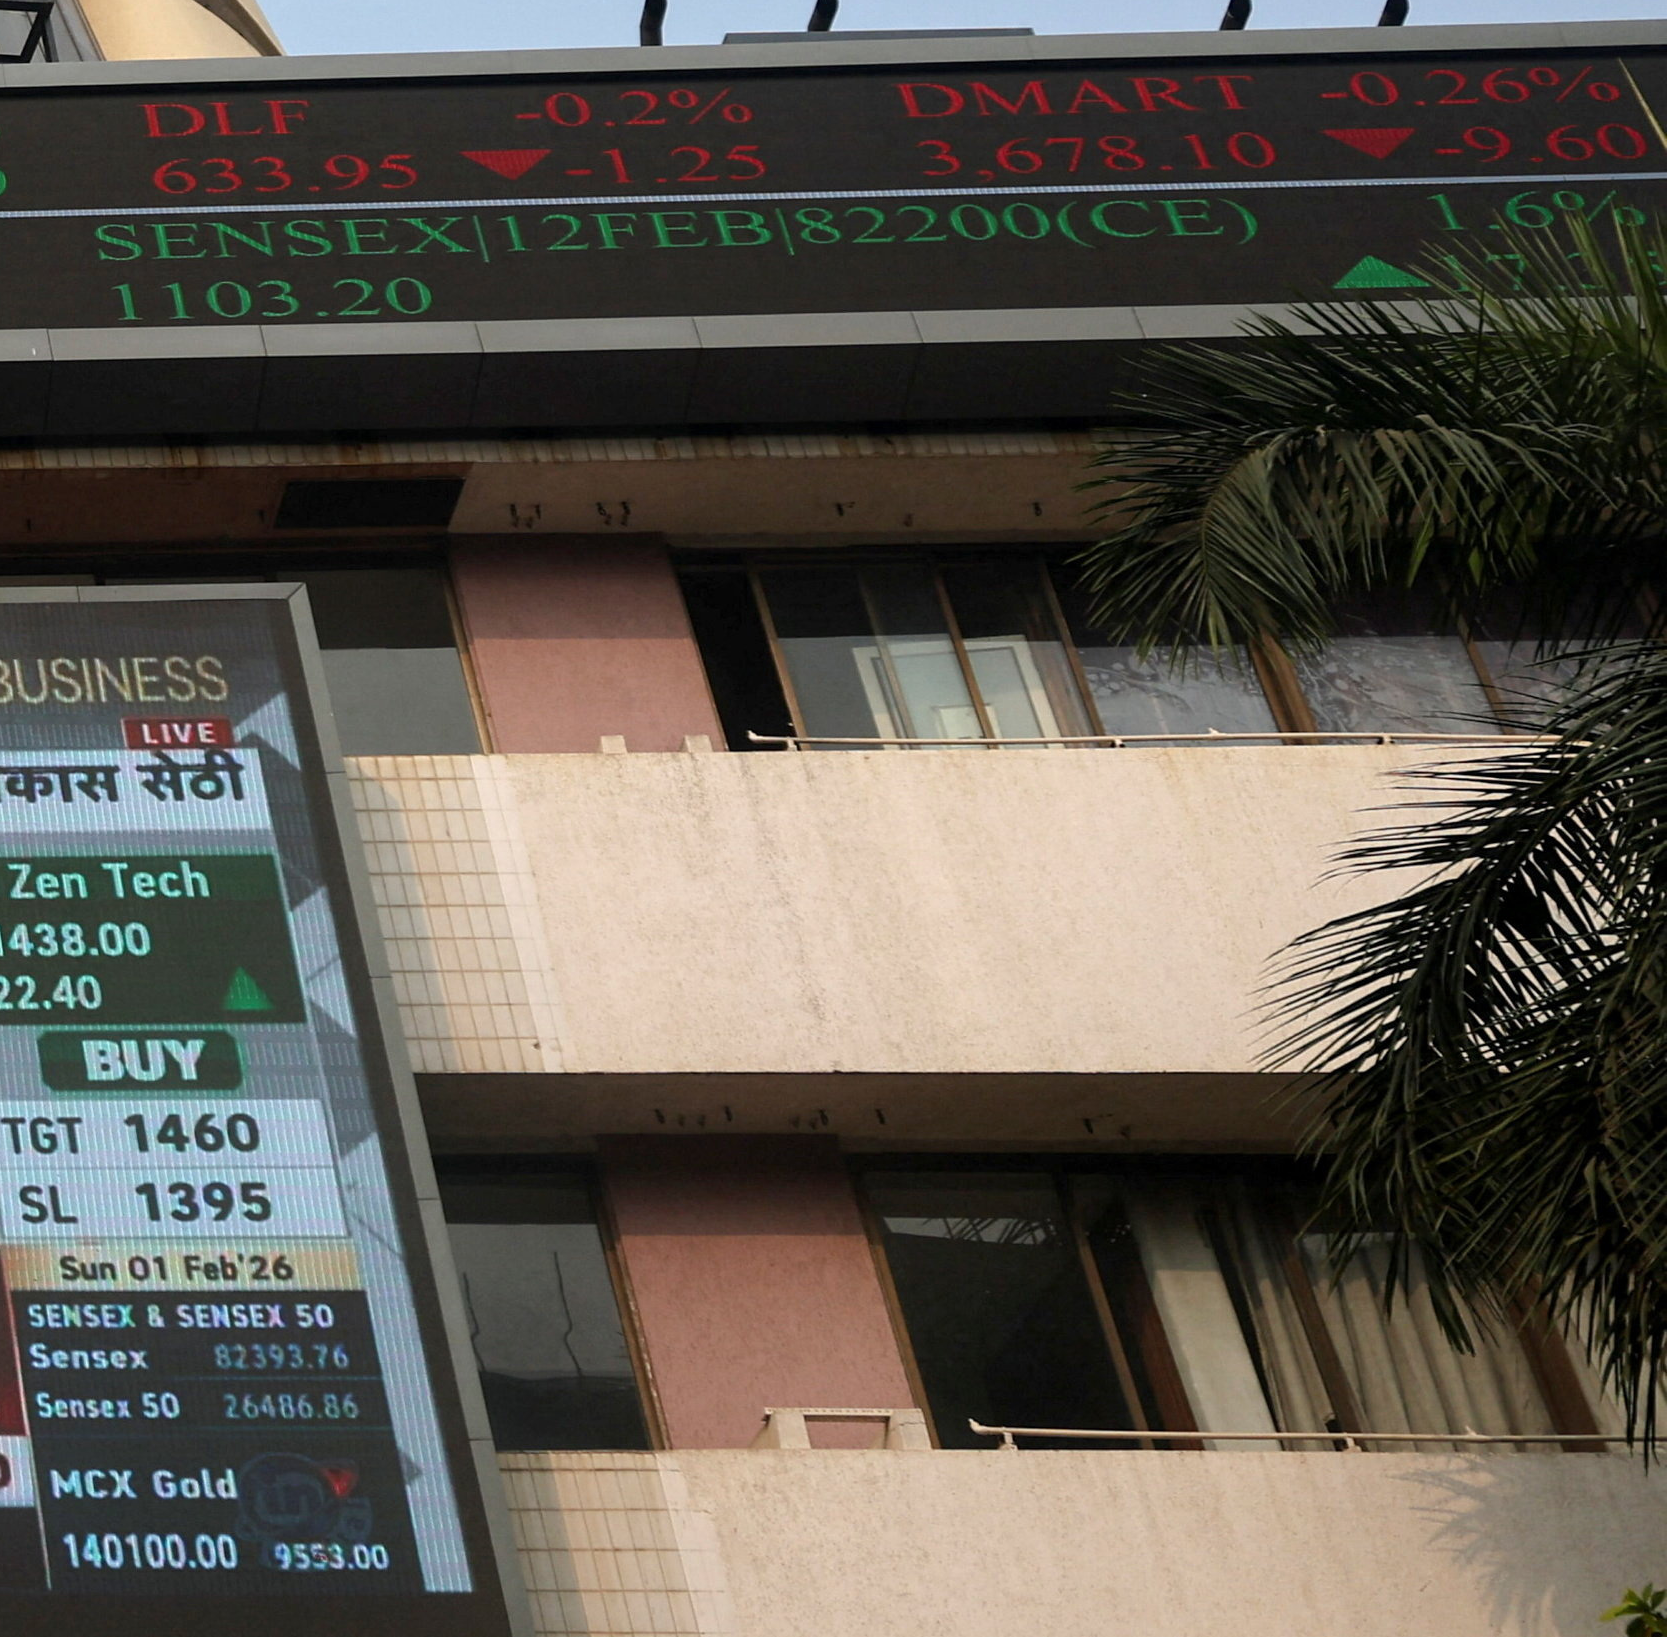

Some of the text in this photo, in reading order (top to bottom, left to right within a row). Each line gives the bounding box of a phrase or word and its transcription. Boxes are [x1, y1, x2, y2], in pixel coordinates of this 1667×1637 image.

[141, 99, 310, 138] DLF
[514, 89, 753, 127] -0.2%
[896, 75, 1252, 118] DMART
[1320, 67, 1621, 106] -0.26%
[152, 153, 418, 195] 633.95
[565, 144, 767, 184] -1.25
[918, 131, 1277, 179] 3,678.10
[1434, 123, 1648, 163] -9.60
[1427, 190, 1647, 231] 1.6%
[113, 277, 434, 321] 1103.20
[141, 722, 216, 745] LIVE
[136, 750, 245, 802] सेठी
[9, 860, 210, 899] Zen Tech
[81, 1039, 205, 1082] BUY
[0, 1112, 260, 1155] TGT 1460
[18, 1181, 272, 1225] SL 1395
[59, 1255, 117, 1282] Sun
[128, 1255, 168, 1282] 01
[28, 1303, 335, 1329] SENSEX & SENSEX 50
[29, 1343, 148, 1370] Sensex
[35, 1391, 131, 1419] Sensex
[142, 1391, 180, 1419] 50
[50, 1468, 238, 1499] MCX Gold
[63, 1533, 238, 1569] 140100.00
